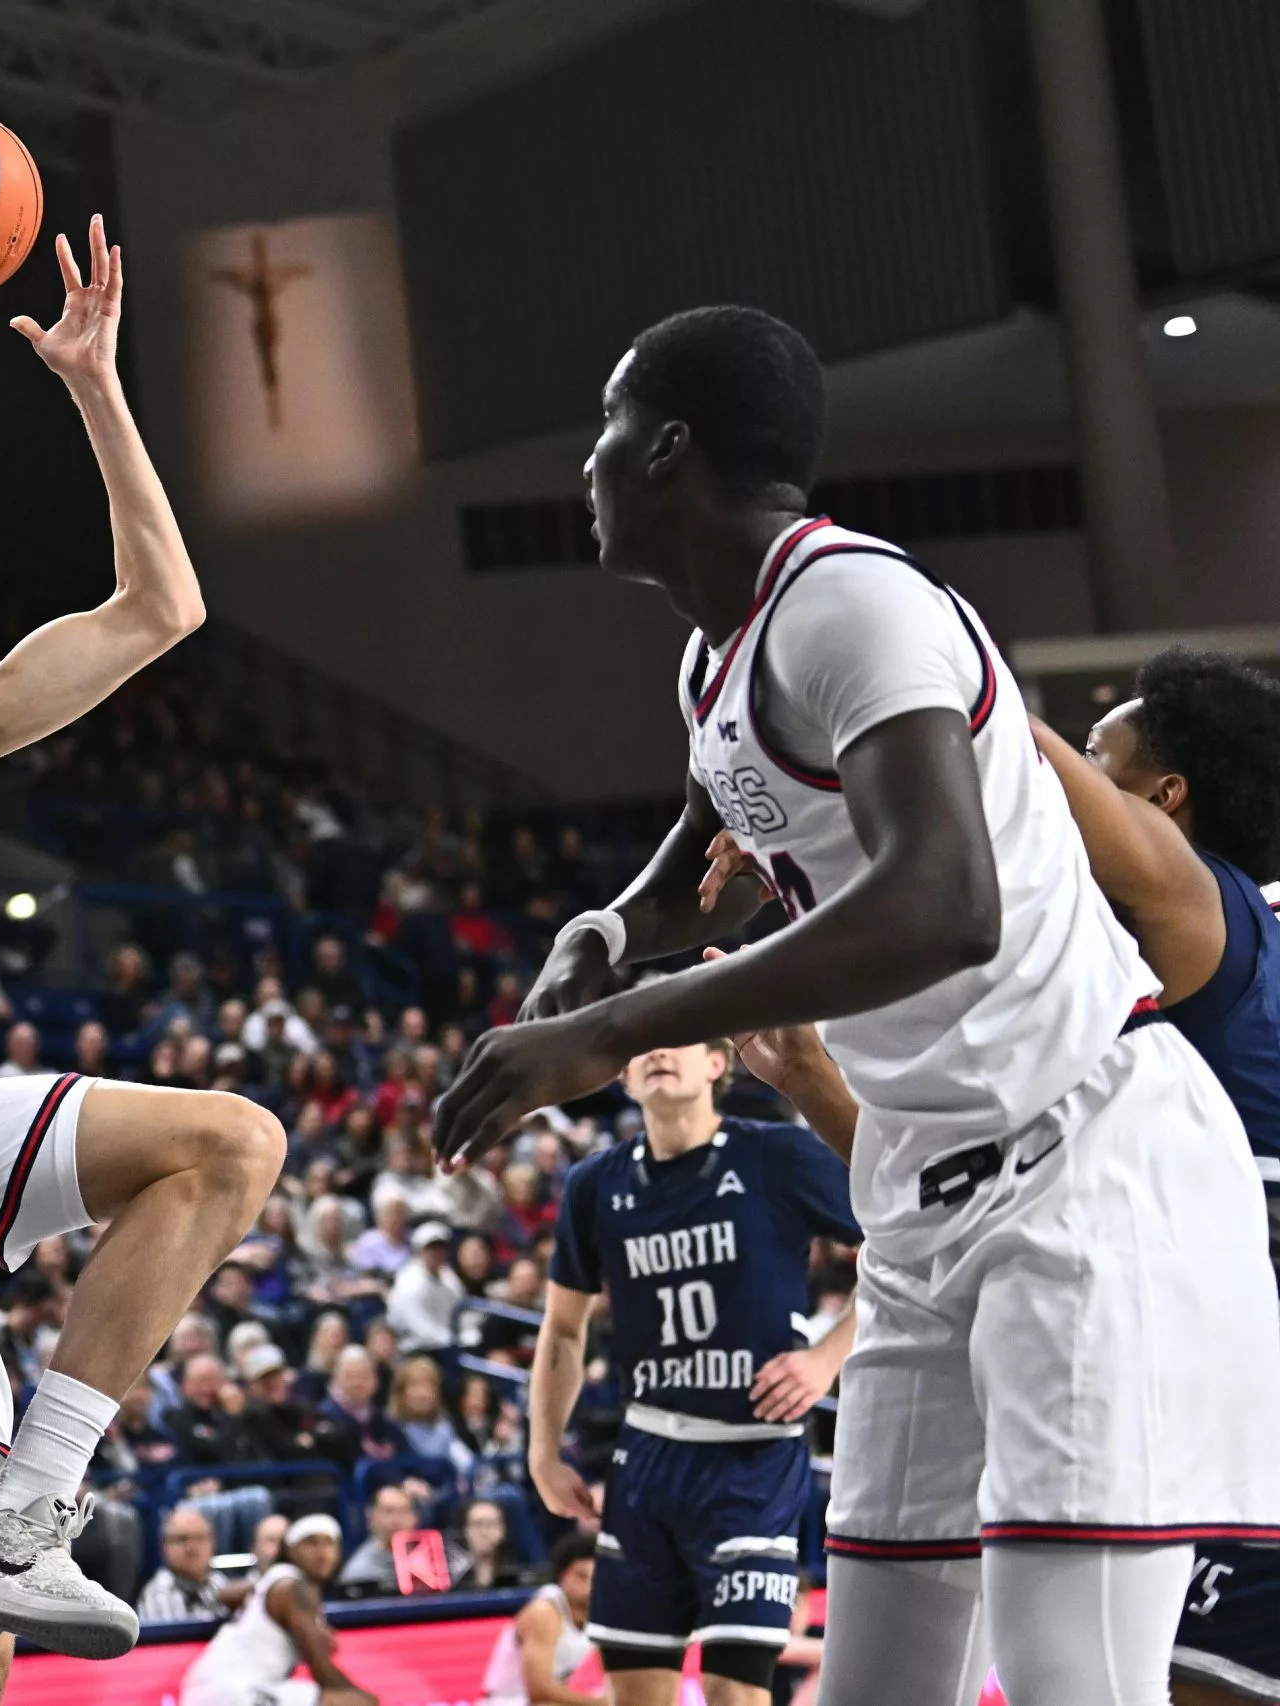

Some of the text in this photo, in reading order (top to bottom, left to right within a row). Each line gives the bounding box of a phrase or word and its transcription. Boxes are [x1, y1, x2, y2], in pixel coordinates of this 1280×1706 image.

[623, 1220, 738, 1279] NORTH
[656, 1279, 719, 1346] 10
[713, 1569, 800, 1611] SPRE
